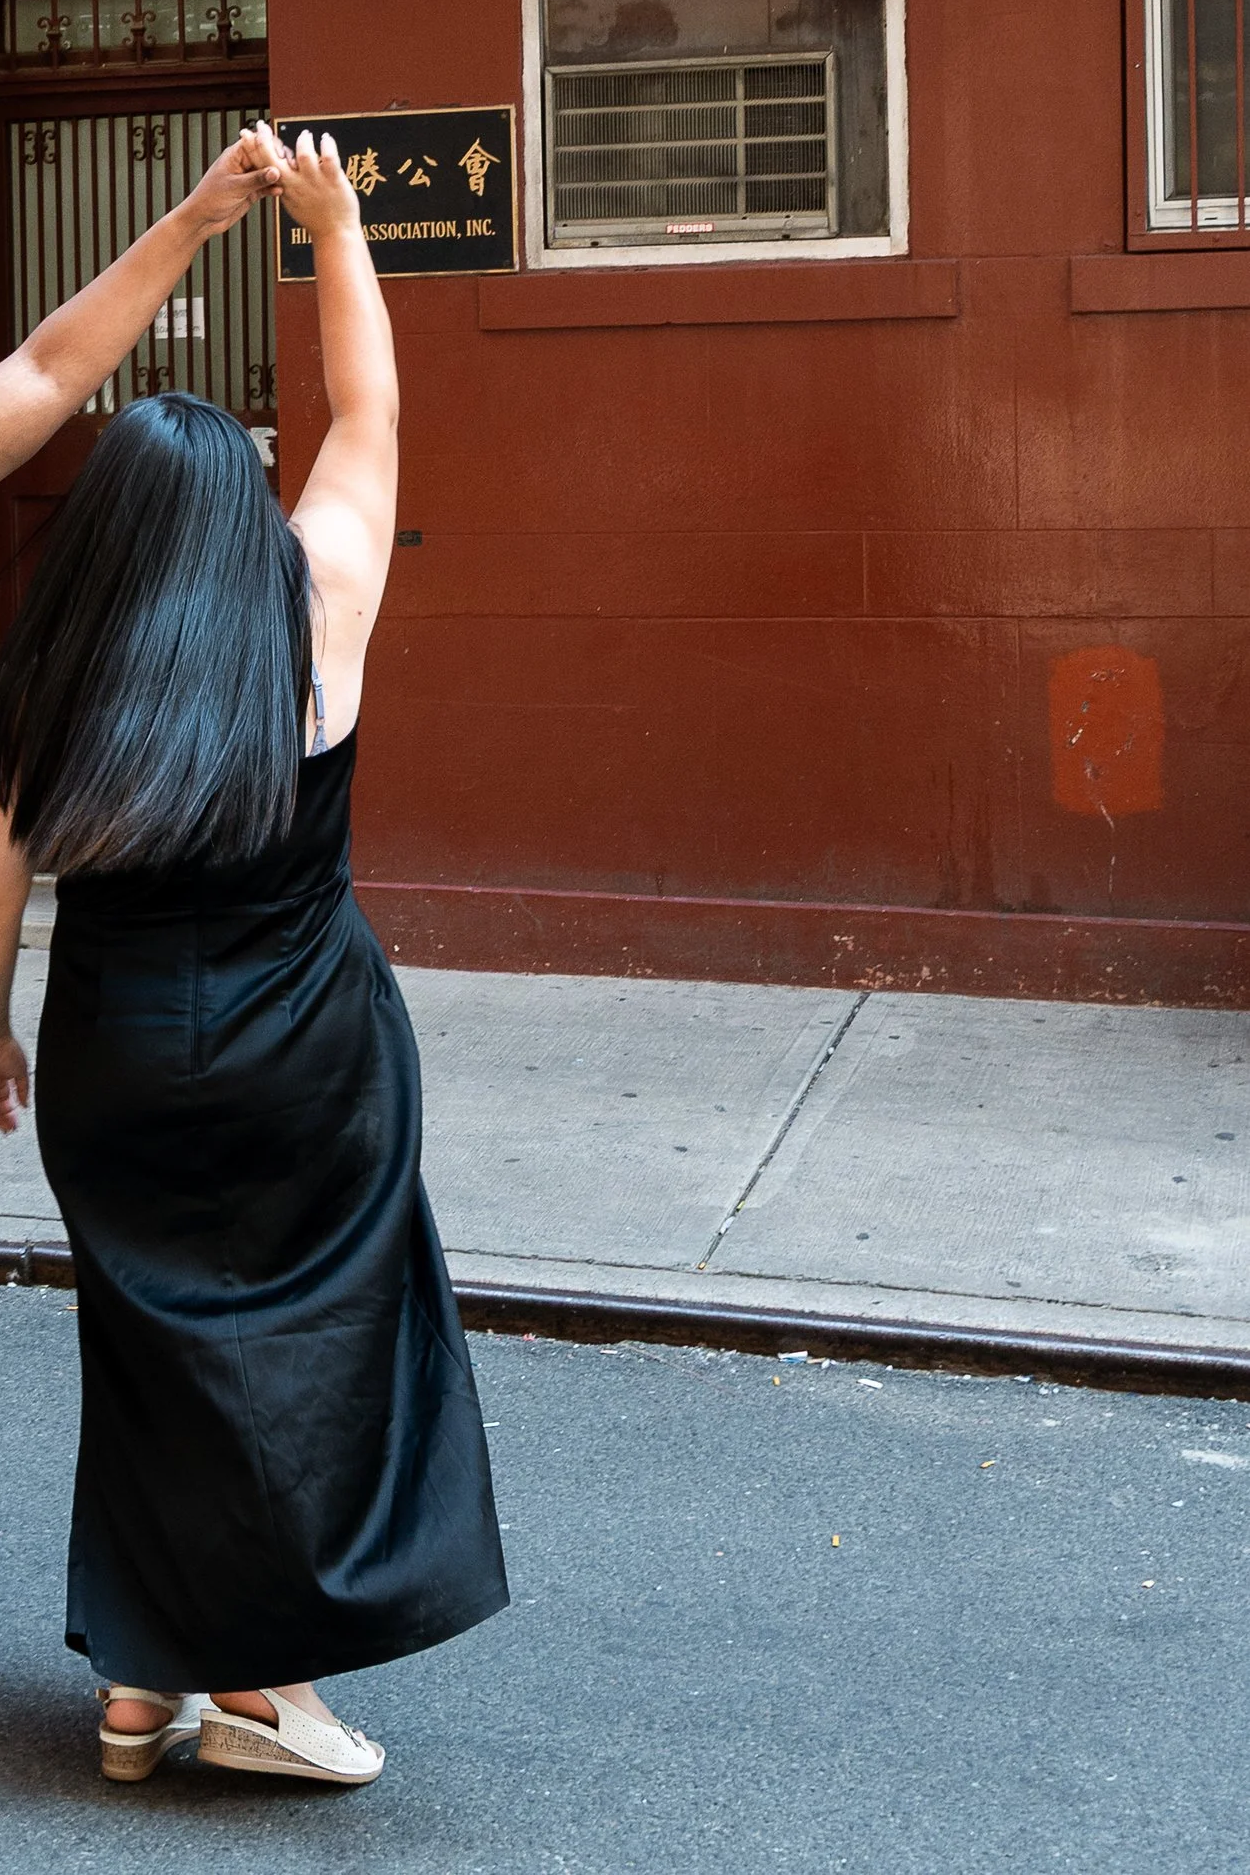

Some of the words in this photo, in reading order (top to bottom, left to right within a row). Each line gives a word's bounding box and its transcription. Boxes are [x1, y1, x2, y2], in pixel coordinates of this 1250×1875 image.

[347, 137, 501, 197] 勝公會
[363, 221, 461, 241] ASSOCIATION,
[466, 219, 496, 237] INC.
